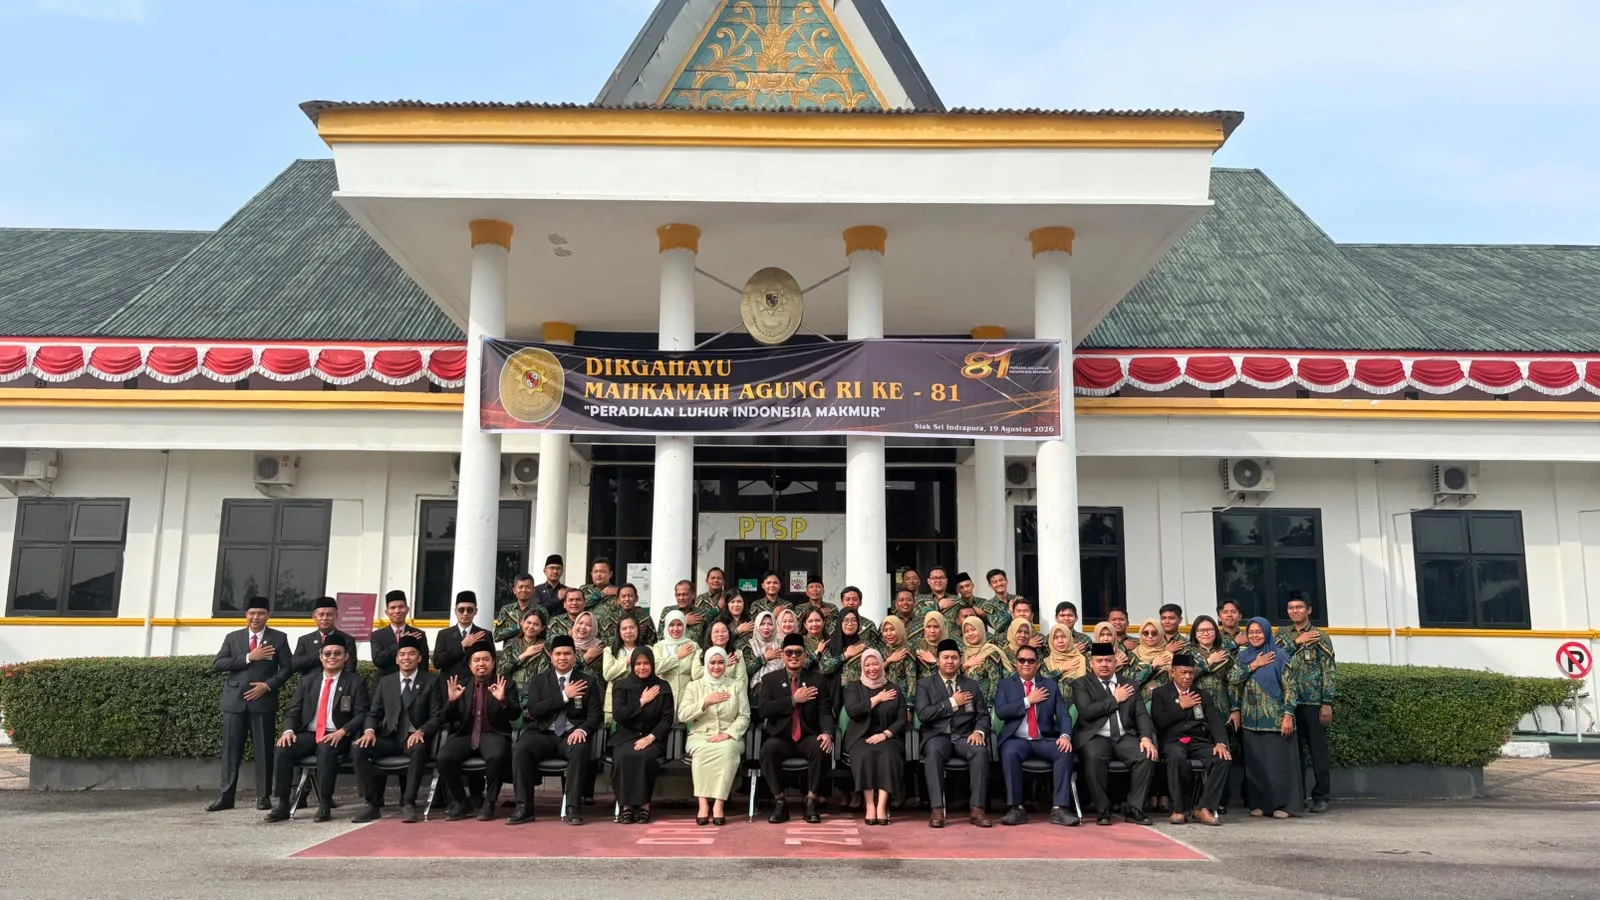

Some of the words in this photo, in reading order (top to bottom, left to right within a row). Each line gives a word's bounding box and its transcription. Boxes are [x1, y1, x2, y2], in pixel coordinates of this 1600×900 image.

[585, 356, 733, 377] DIRGAHAYU
[960, 351, 1013, 379] 81
[585, 382, 731, 400] MAHKAMAH
[739, 381, 826, 401] AGUNG
[836, 381, 862, 399] RI
[872, 382, 905, 401] KE
[930, 383, 961, 402] 81
[583, 405, 675, 418] "PERADILAN
[679, 406, 728, 418] LUHUR
[732, 406, 811, 418] INDONESIA
[815, 405, 887, 418] MAKMUR"
[946, 424, 987, 433] Indrapura,
[1000, 425, 1032, 434] Agustus
[738, 515, 808, 541] PTSP
